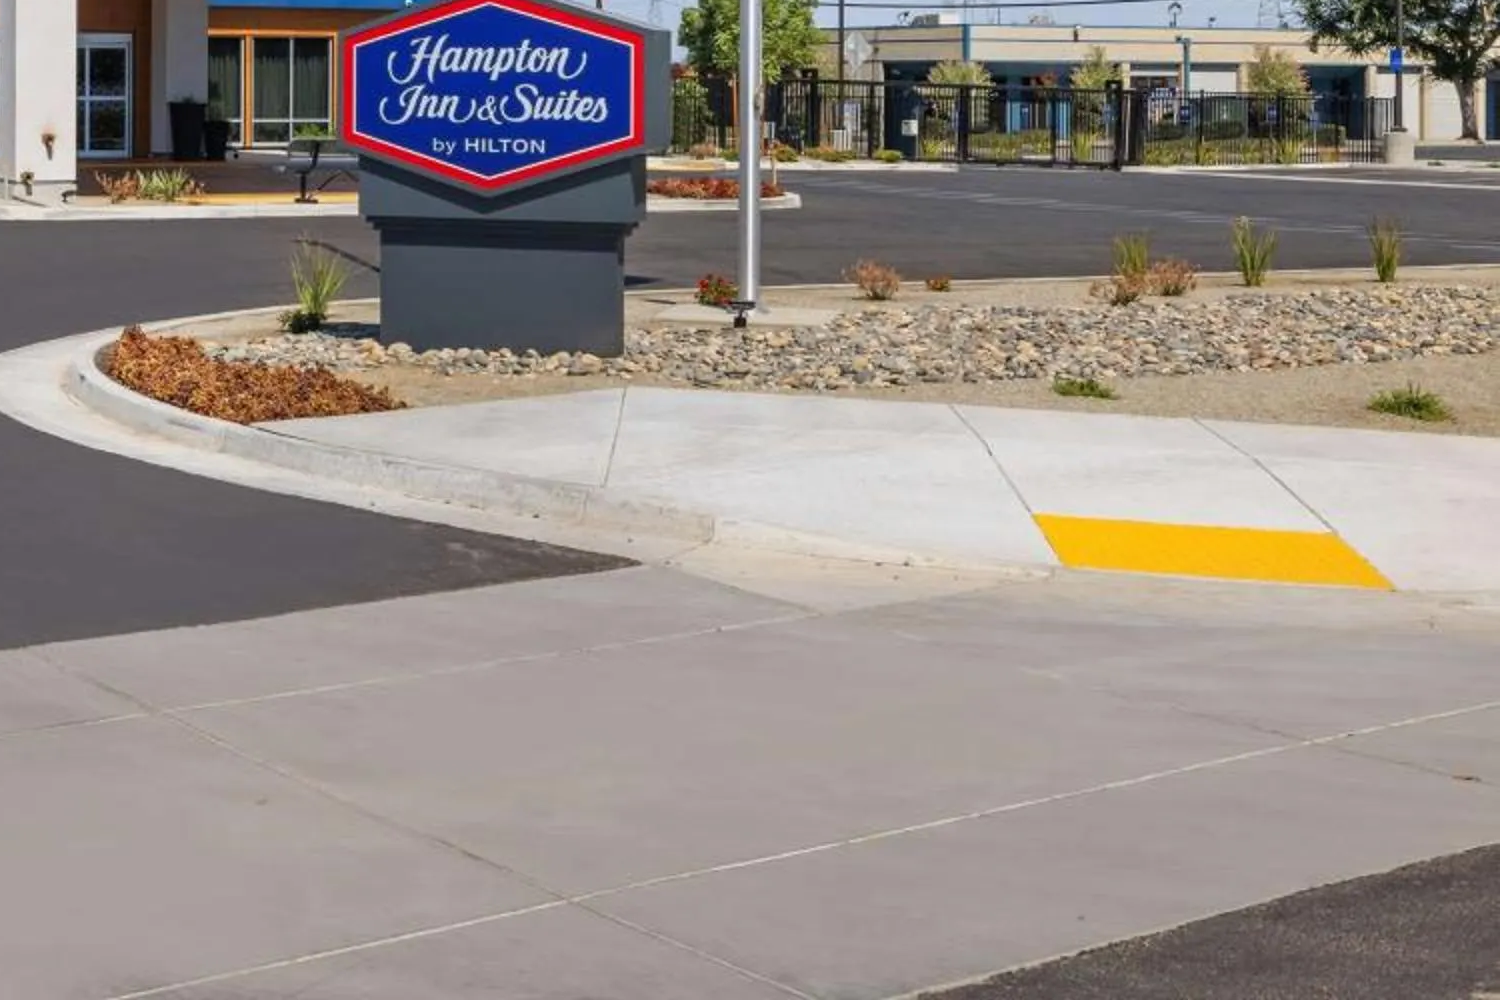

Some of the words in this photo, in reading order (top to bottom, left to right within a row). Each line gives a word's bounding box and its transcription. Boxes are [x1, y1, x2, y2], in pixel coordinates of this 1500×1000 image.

[387, 34, 587, 84] Hampton
[379, 84, 477, 124] Inn
[476, 95, 503, 124] &
[500, 83, 609, 124] Suites
[432, 137, 456, 155] by
[464, 138, 546, 154] HILTON
